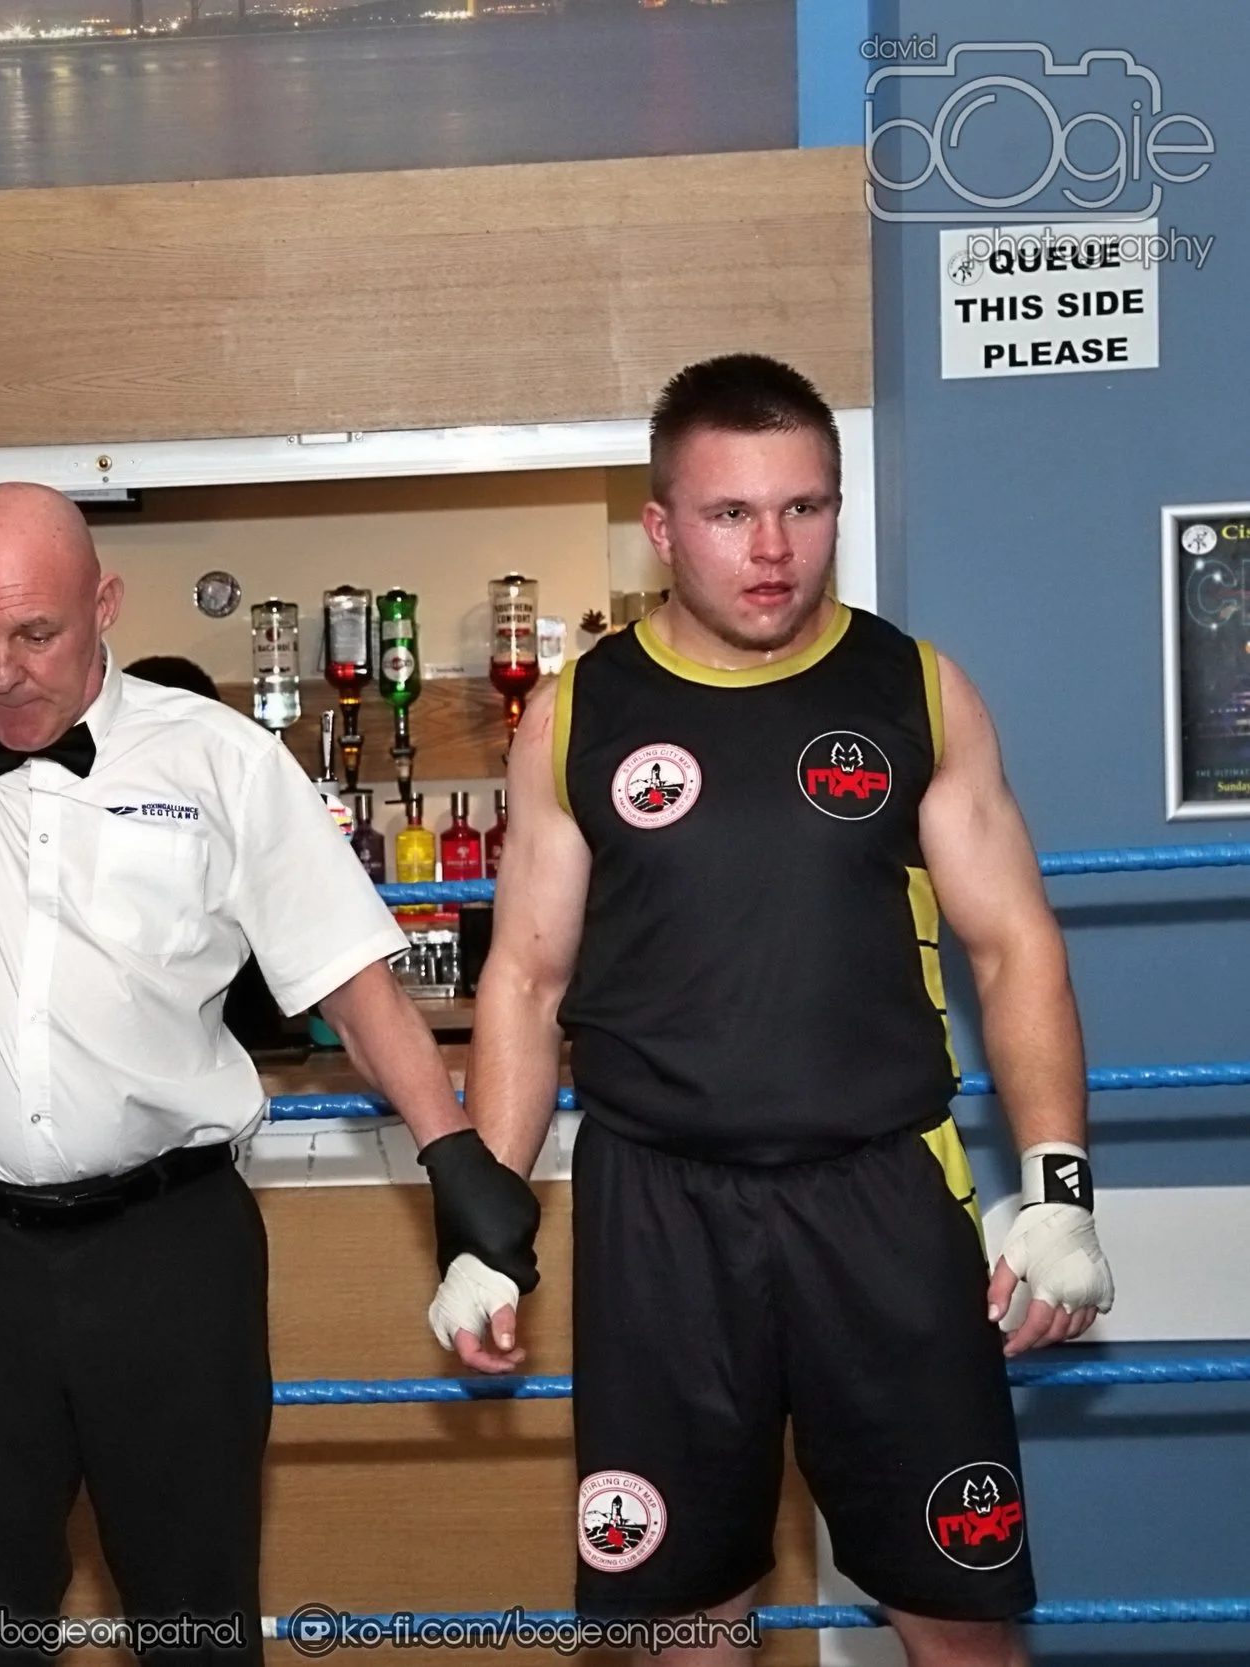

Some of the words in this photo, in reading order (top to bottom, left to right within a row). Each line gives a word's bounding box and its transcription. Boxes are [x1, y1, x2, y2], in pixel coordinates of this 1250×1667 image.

[989, 243, 1121, 275] QUEUE
[954, 295, 1043, 323] THIS
[1057, 289, 1144, 318] SIDE
[983, 337, 1129, 369] PLEASE
[623, 750, 658, 773] STIRLING
[660, 749, 678, 757] CITY
[807, 767, 888, 799] MXP
[141, 809, 199, 820] SCOTLAND
[581, 1478, 620, 1498] STIRLING
[623, 1480, 643, 1492] CITY
[937, 1501, 1023, 1547] MXP
